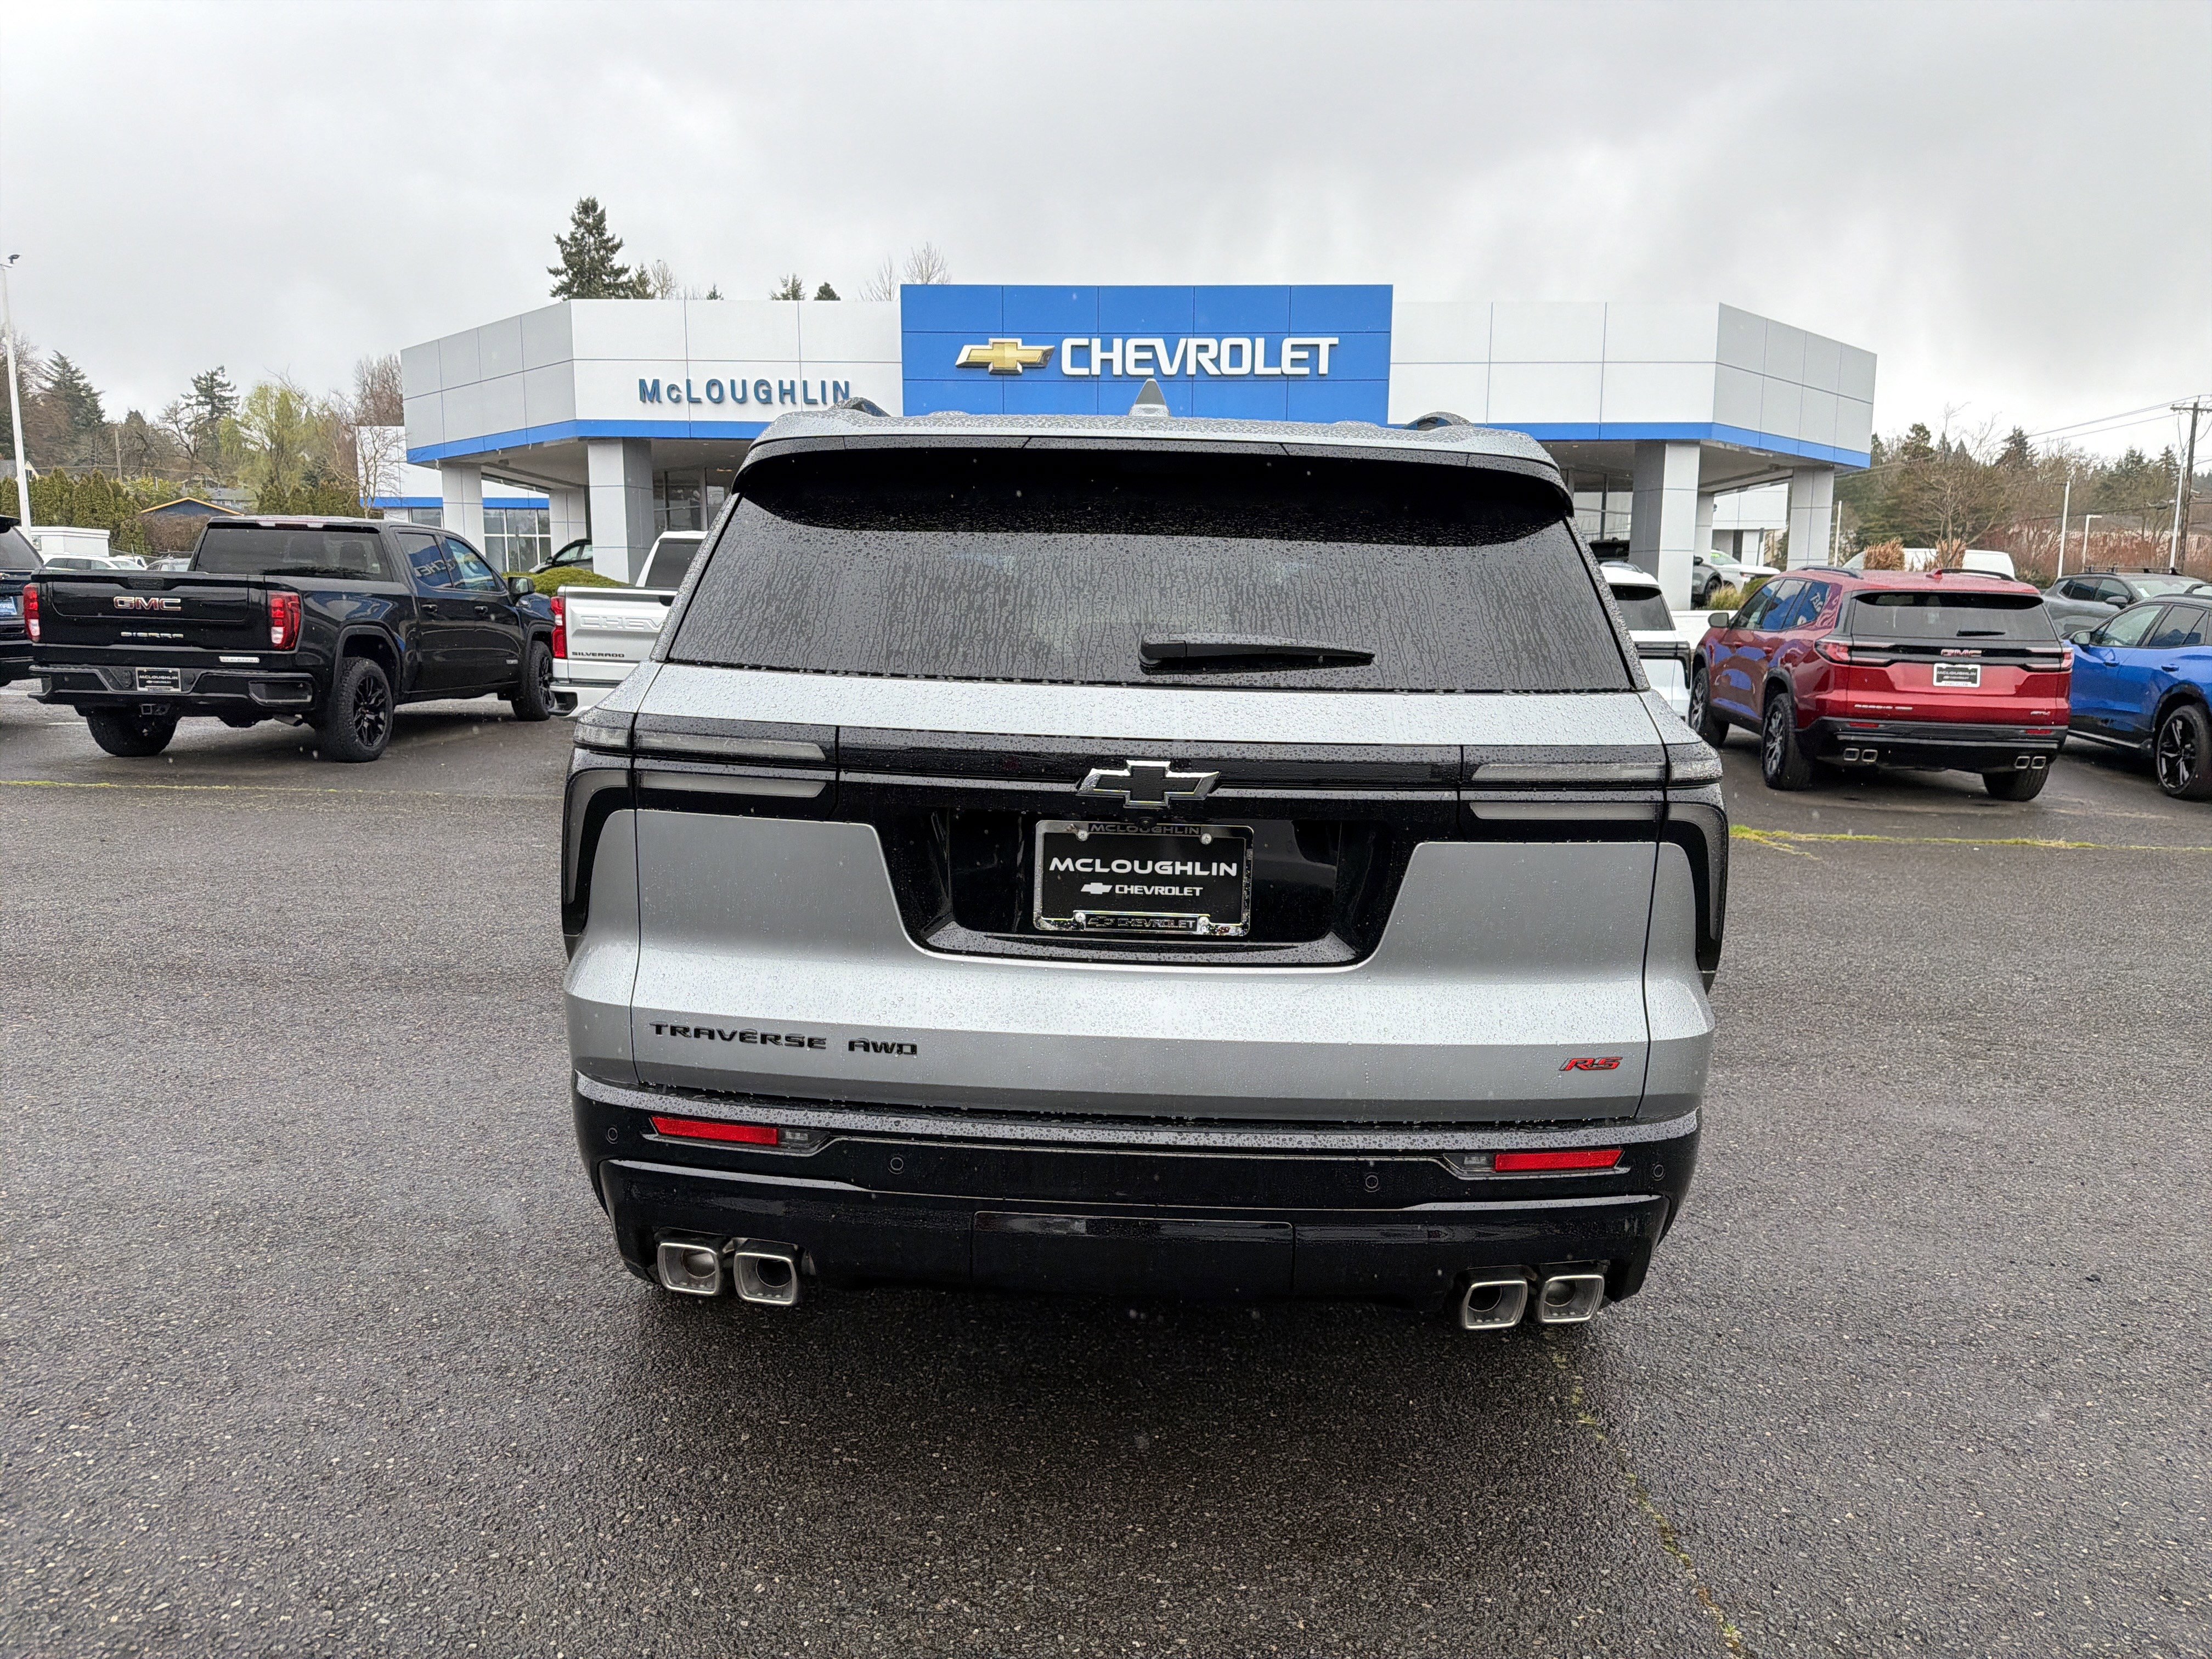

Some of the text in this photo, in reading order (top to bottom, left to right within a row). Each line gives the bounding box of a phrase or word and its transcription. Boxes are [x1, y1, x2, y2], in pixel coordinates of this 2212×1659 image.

[1061, 337, 1340, 376] CHEVROLET
[639, 379, 850, 404] McLOUGHLIN
[113, 596, 182, 611] GMC
[1940, 648, 1982, 658] GMC
[1090, 823, 1200, 835] MCLOUGHLIN
[1049, 857, 1238, 877] MCLOUGHLIN
[1114, 884, 1204, 896] CHEVROLET
[1117, 917, 1196, 929] CHEVROLET
[649, 1020, 918, 1056] TRAVERSE AWD
[1558, 1056, 1623, 1071] RS
